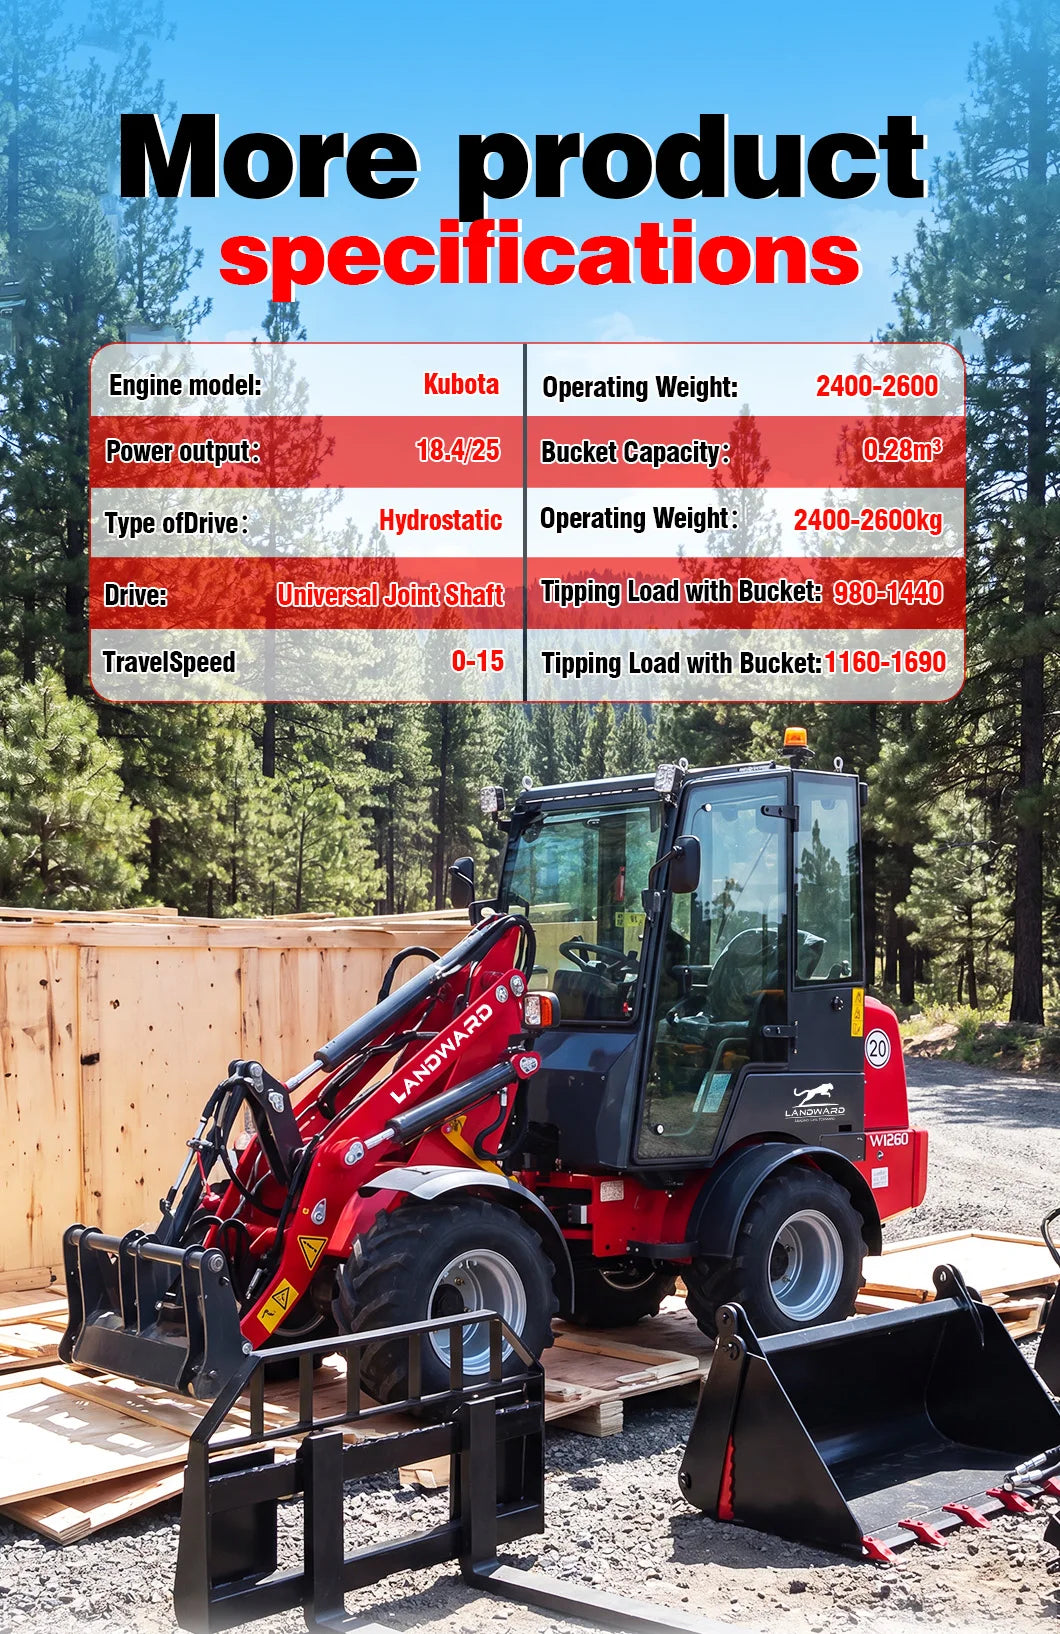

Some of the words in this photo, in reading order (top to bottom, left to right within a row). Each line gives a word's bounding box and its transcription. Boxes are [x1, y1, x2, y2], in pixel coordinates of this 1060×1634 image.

[389, 1003, 493, 1104] LANDWARD
[869, 1039, 887, 1057] 20
[784, 1106, 846, 1117] LANDWARD
